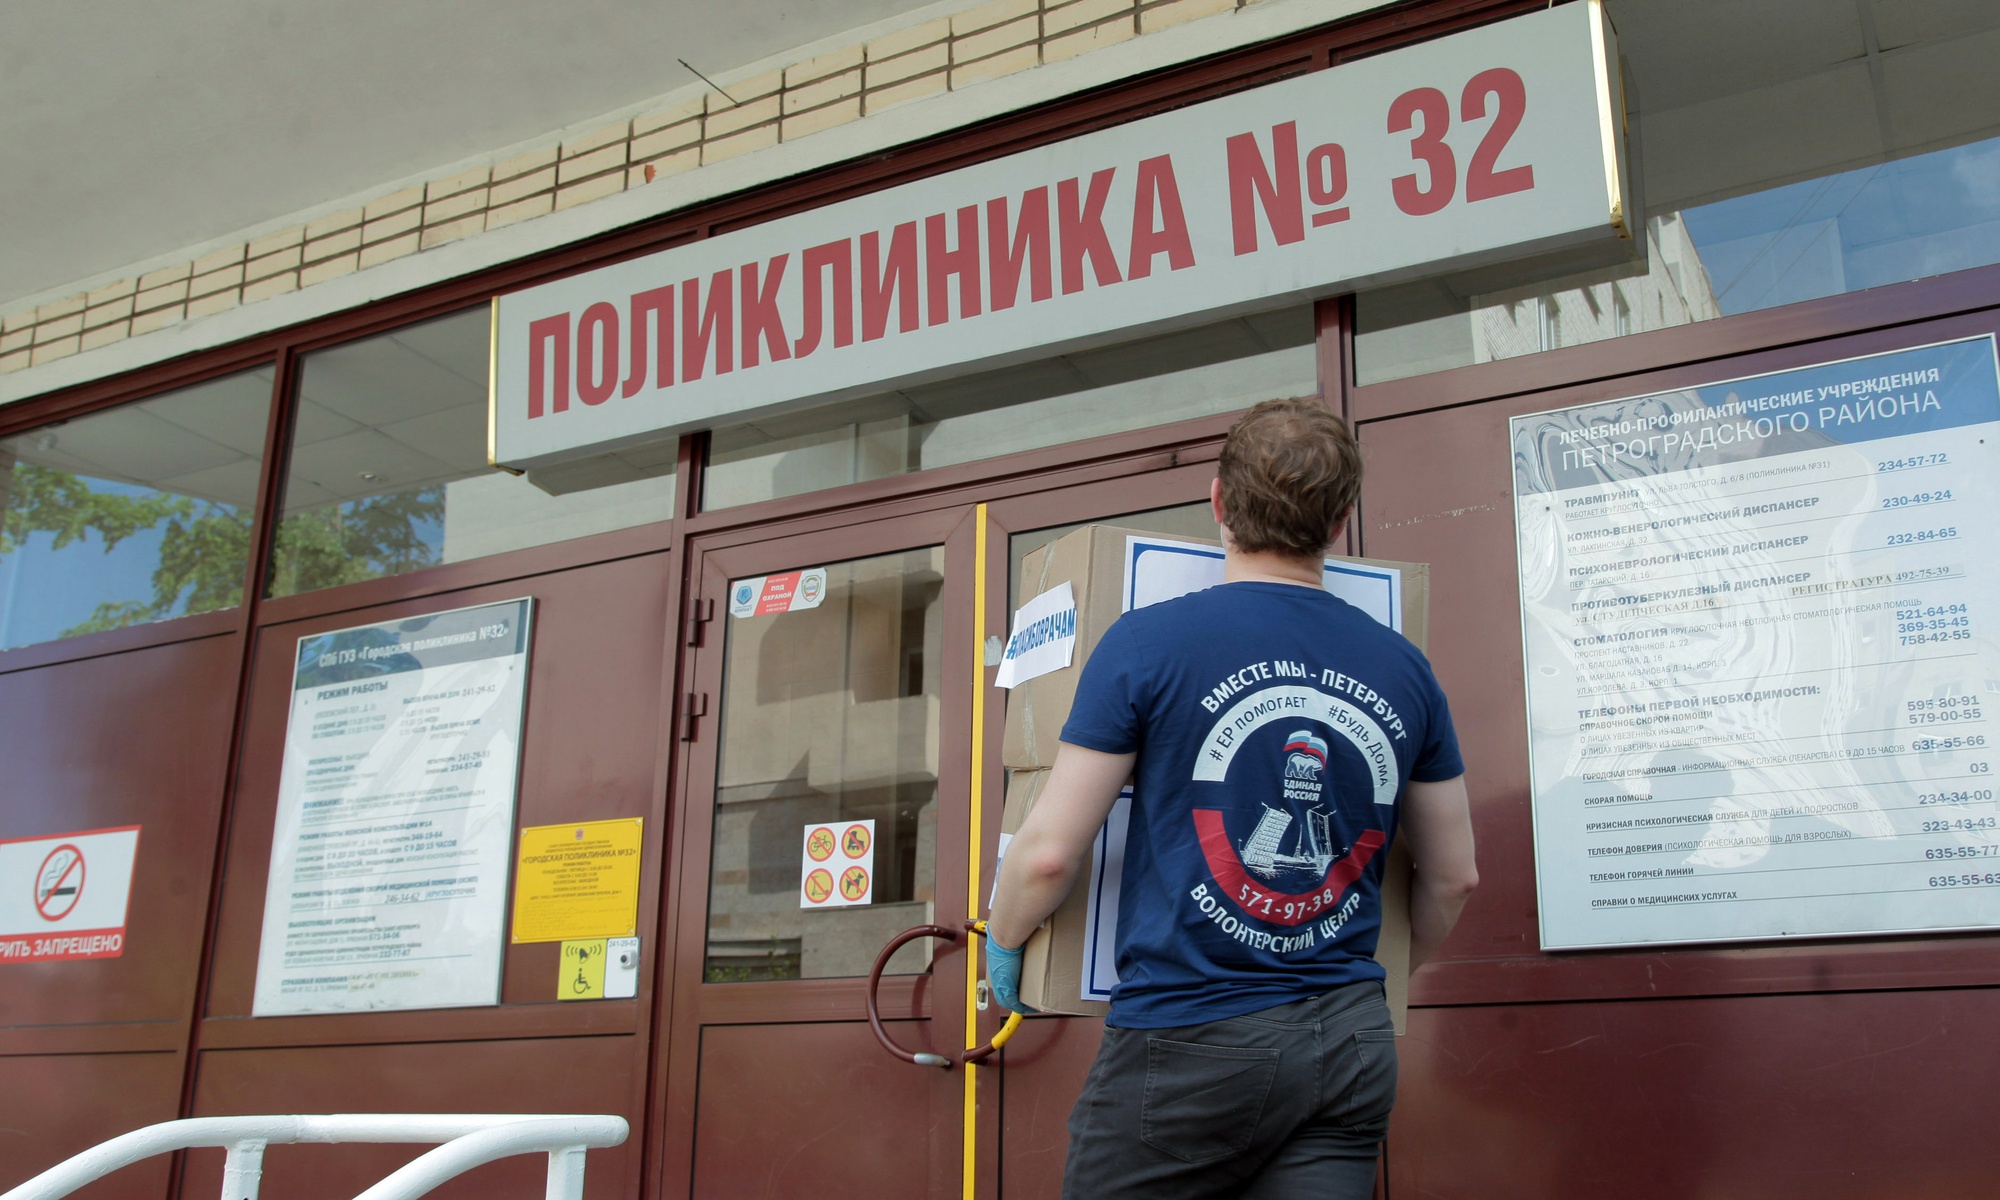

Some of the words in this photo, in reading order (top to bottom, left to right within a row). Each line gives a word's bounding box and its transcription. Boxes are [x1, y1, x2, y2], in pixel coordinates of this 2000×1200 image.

[527, 154, 1196, 419] ПОЛИКЛИНИКА
[1226, 120, 1350, 257] №
[1386, 66, 1536, 216] 32
[1559, 389, 1813, 445] ЛЕЧЕБНО-ПРОФИЛАКТИЧЕСКИЕ
[1819, 368, 1939, 402] УЧРЕЖДЕНИЯ
[1562, 410, 1809, 473] ПЕТРОГРАДСКОГО
[1818, 384, 1941, 428] РАЙОНА
[1877, 452, 1947, 472] 234-57-72
[1730, 472, 1745, 483] 6/8
[1882, 489, 1952, 508] 230-49-24
[1567, 506, 1740, 542] КОЖНО-ВЕНЕРОЛОГИЧЕСКИЙ
[1742, 496, 1819, 517] ДИСПАНСЕР
[1886, 526, 1957, 545] 232-84-65
[1568, 543, 1728, 576] ПСИХОНЕВРОЛОГИЧЕСКИЙ
[1732, 534, 1809, 555] ДИСПАНСЕР
[1790, 573, 1893, 596] РЕГИСТРАТУРА
[1894, 565, 1949, 581] 492-75-39
[1571, 580, 1730, 611] ПРОТИВОТУБЕРКУЛЕЗНЫЙ
[1733, 571, 1811, 591] ДИСПАНСЕР
[1896, 602, 1967, 620] 521-64-94
[1897, 615, 1969, 633] 369-35-45
[1573, 627, 1668, 647] СТОМАТОЛОГИЯ
[1899, 628, 1970, 646] 758-42-55
[317, 686, 350, 700] РЕЖИМ
[350, 680, 388, 695] РАБОТЫ
[1201, 661, 1272, 713] ВМЕСТЕ
[1274, 660, 1306, 678] МЫ
[1321, 669, 1407, 740] ПЕТЕРБУРГ
[1578, 703, 1646, 719] ТЕЛЕФОНЫ
[1649, 695, 1699, 711] ПЕРВОЙ
[1702, 684, 1820, 707] НЕОБХОДИМОСТИ:
[1907, 694, 1980, 711] 595-80-91
[1234, 696, 1307, 731] ПОМОГАЕТ
[1579, 718, 1634, 731] СПРАВОЧНОЕ
[1635, 712, 1670, 725] СКОРОЙ
[1672, 710, 1712, 723] ПОМОЩИ
[1908, 708, 1981, 724] 579-00-55
[1912, 735, 1985, 751] 635-55-66
[1969, 761, 1989, 773] 03
[1284, 779, 1322, 791] ЕДИНАЯ
[1283, 789, 1320, 801] РОССИЯ
[1584, 795, 1614, 806] СКОРАЯ
[1616, 792, 1652, 803] ПОМОЩЬ
[1918, 789, 1992, 804] 234-34-00
[1921, 816, 1996, 832] 323-43-43
[564, 850, 616, 860] ПОЛИКЛИНИКА
[1924, 845, 1999, 859] 635-55-77
[1589, 872, 1625, 881] ТЕЛЕФОН
[1627, 868, 1663, 878] ГОРЯЧЕЙ
[1664, 867, 1693, 876] ЛИНИИ
[1239, 884, 1333, 919] 571-97-38
[1591, 897, 1627, 907] СПРАВКИ
[1629, 897, 1635, 905] О
[1637, 893, 1699, 904] МЕДИЦИНСКИХ
[1701, 891, 1737, 901] УСЛУГАХ
[1190, 883, 1315, 953] ВОЛОНТЕРСКИЙ
[1319, 893, 1360, 939] ЦЕНТР
[33, 934, 122, 955] ЗАПРЕЩЕНО
